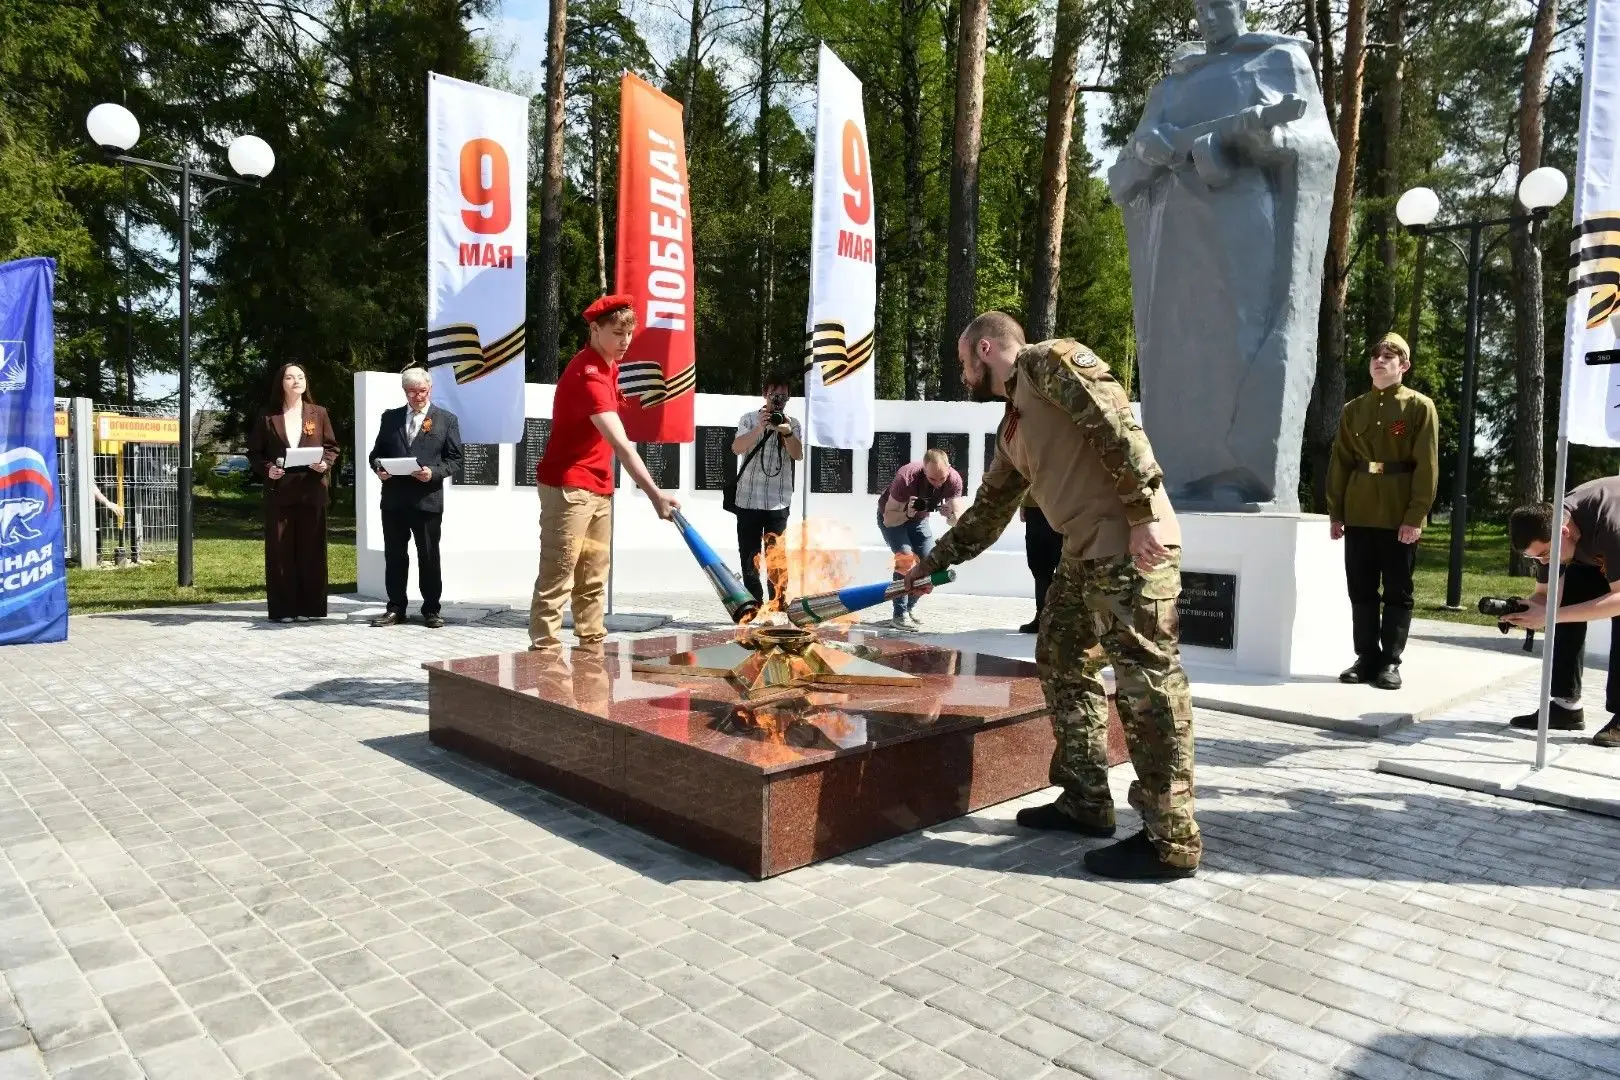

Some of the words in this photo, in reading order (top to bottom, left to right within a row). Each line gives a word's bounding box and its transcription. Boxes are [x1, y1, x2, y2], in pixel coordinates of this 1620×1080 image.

[460, 138, 511, 235] 9
[843, 119, 871, 226] 9
[646, 128, 687, 331] ПОБЕДА!
[459, 242, 513, 269] МАЯ
[838, 230, 873, 264] МАЯ
[54, 416, 66, 426] АЗ
[164, 423, 177, 433] ГАЗ
[0, 542, 53, 574] НАЯ
